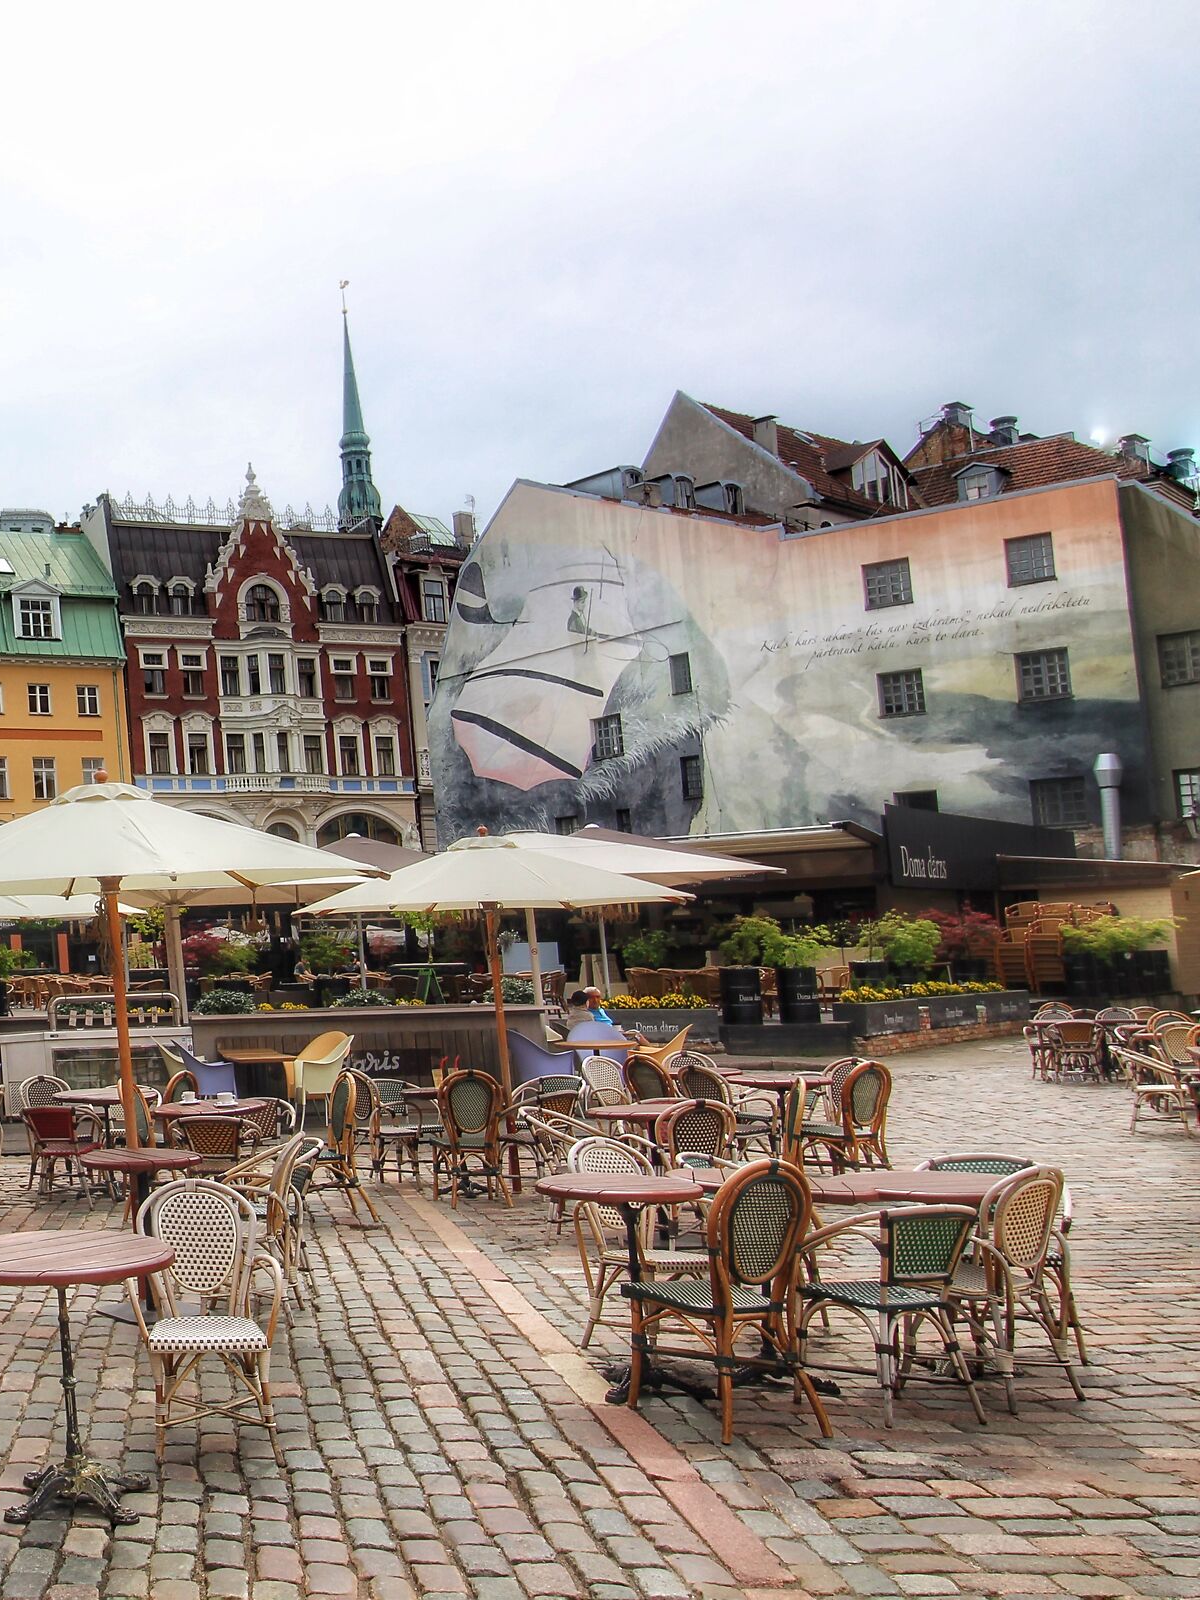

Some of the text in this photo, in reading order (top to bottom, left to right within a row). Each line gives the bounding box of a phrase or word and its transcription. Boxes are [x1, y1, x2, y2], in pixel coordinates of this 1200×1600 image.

[888, 623, 908, 633] nav
[935, 631, 947, 642] to
[900, 845, 927, 877] Doma
[635, 1020, 658, 1033] Doma
